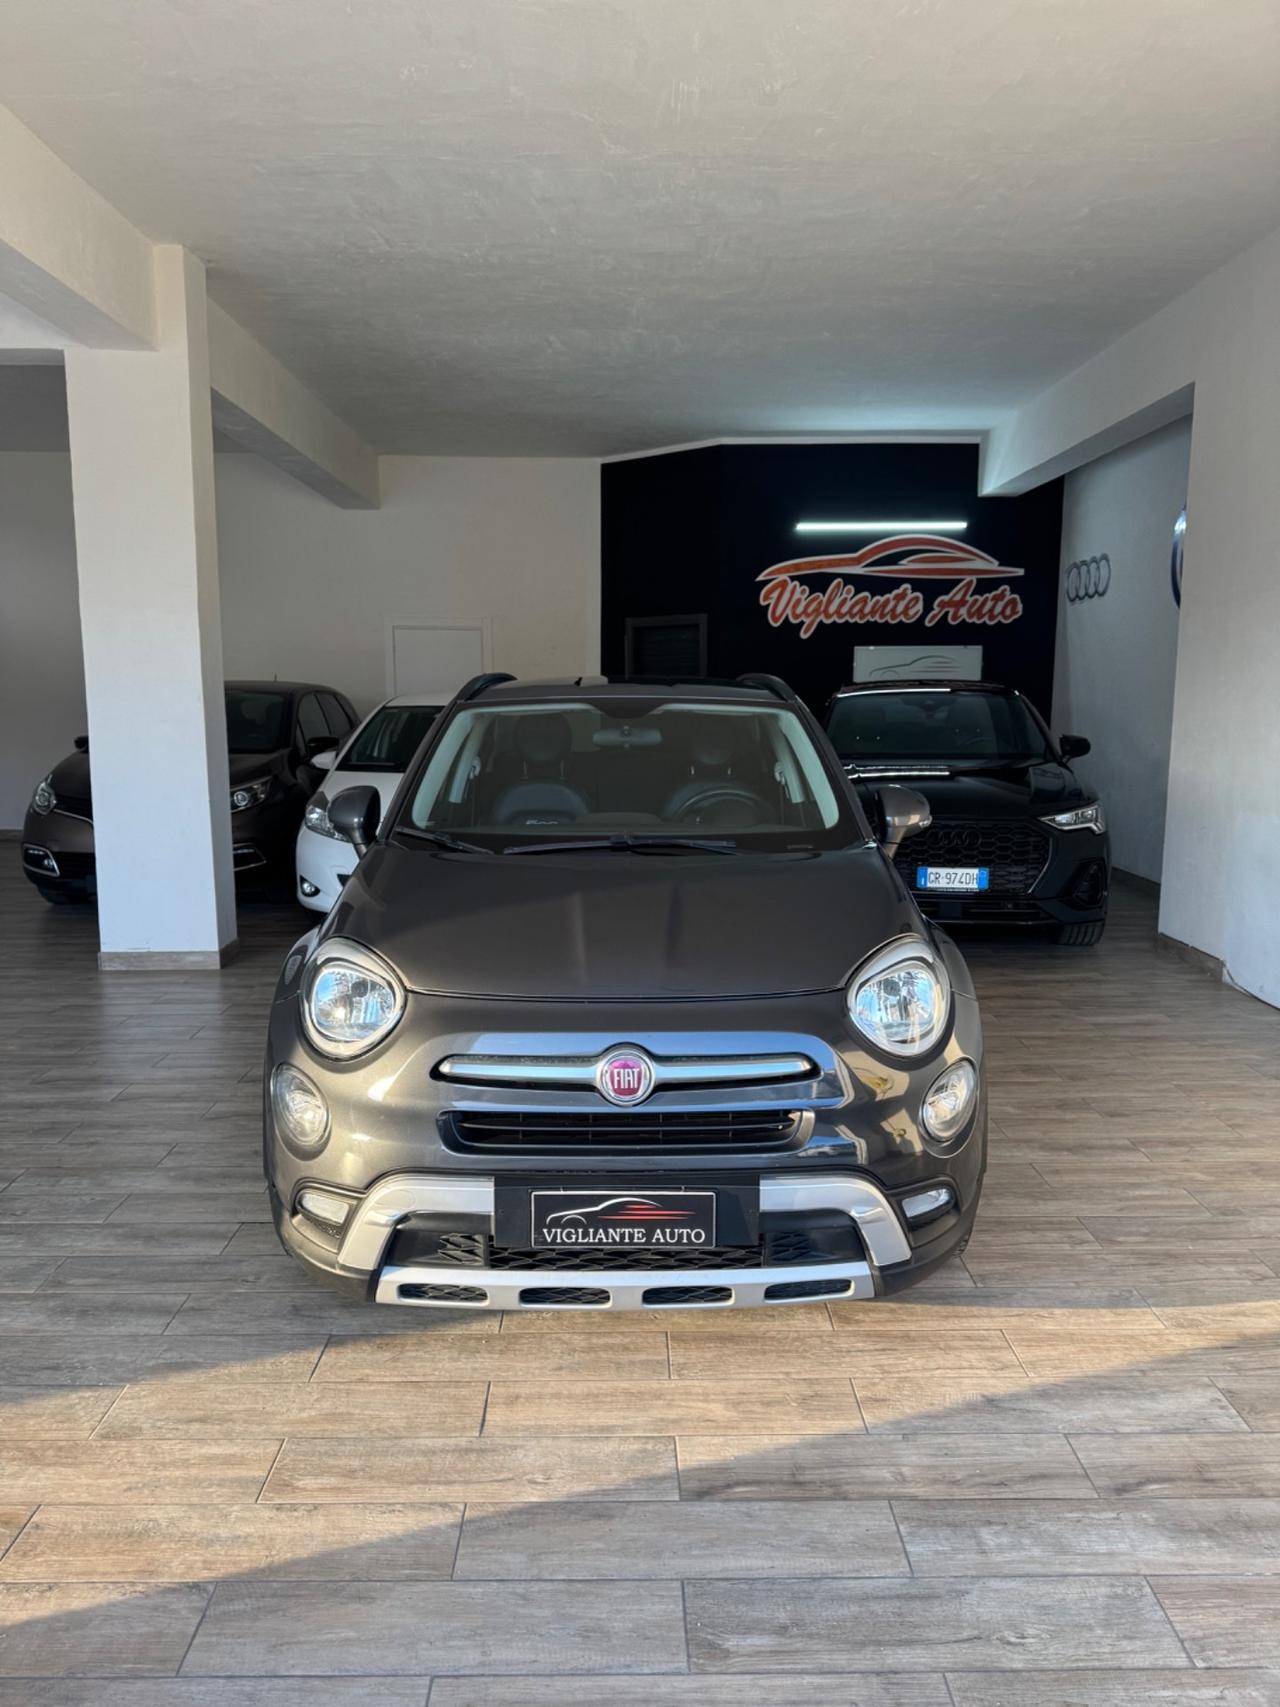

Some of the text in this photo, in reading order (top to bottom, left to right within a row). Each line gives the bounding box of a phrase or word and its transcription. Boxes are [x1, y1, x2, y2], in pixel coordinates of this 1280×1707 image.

[760, 575, 1023, 639] Vigliante Auto
[945, 871, 979, 885] 974DH
[613, 1068, 640, 1089] FIAT
[542, 1228, 706, 1243] VIGLIANTE AUTO
